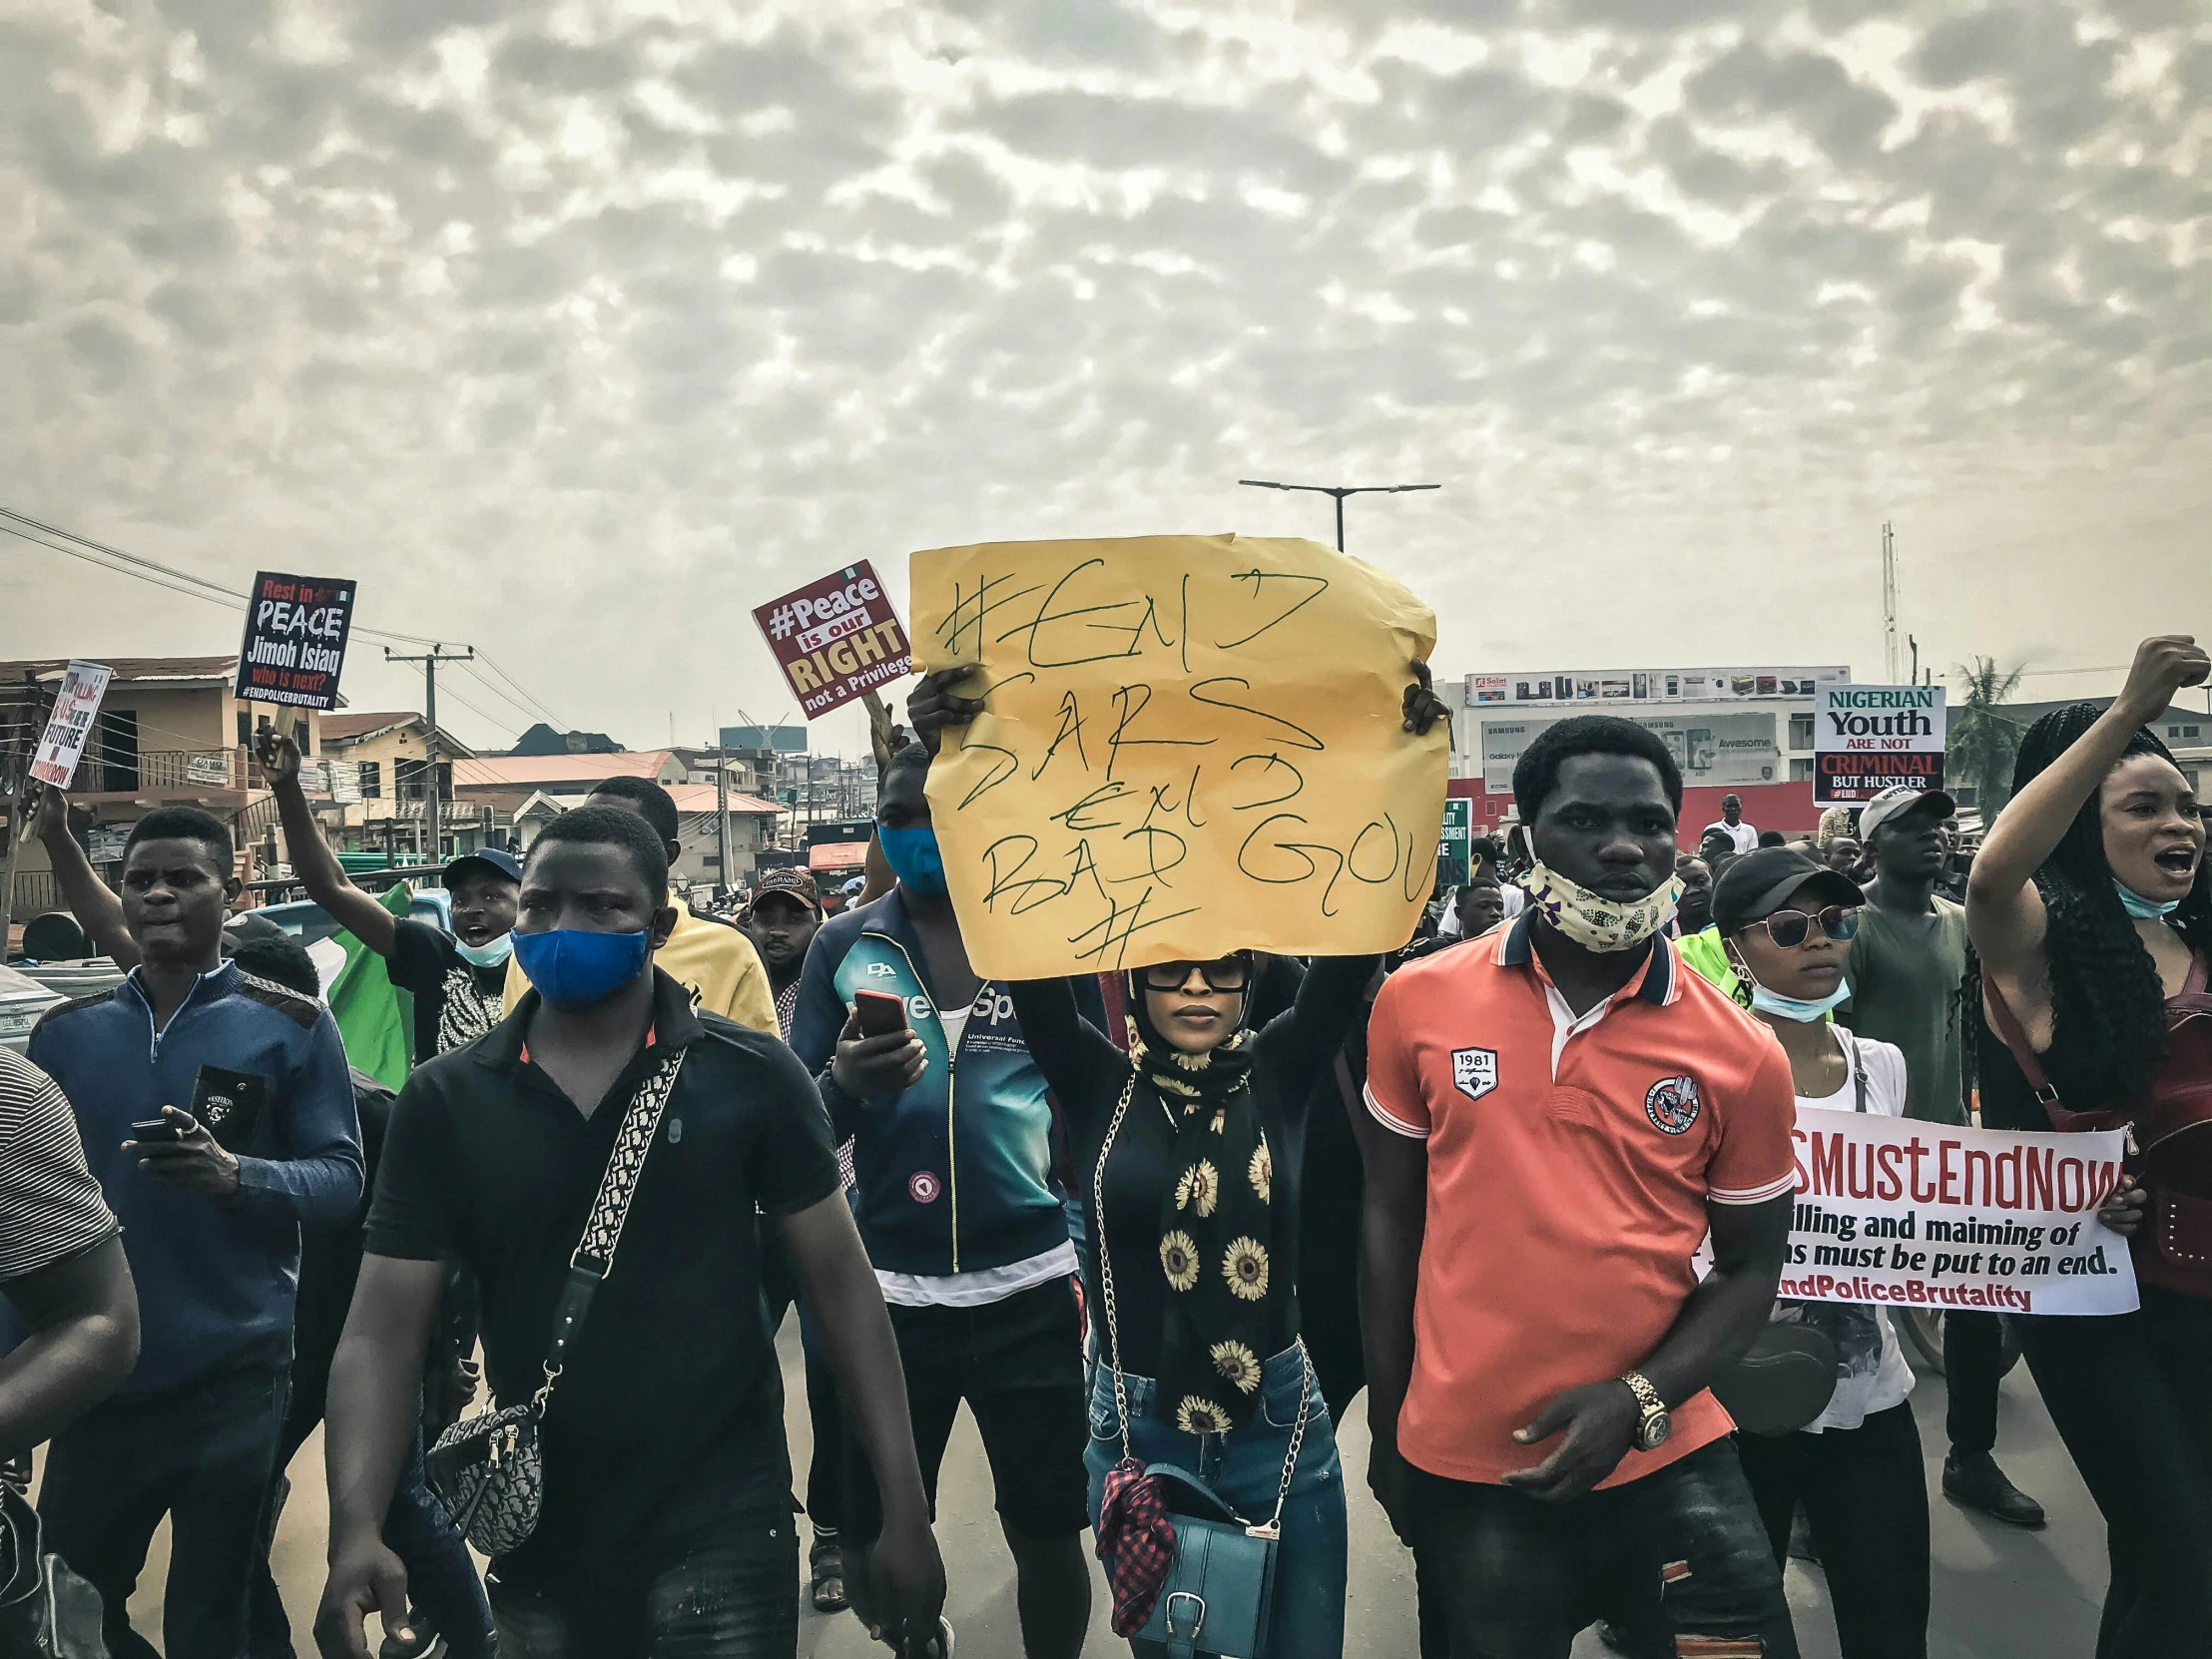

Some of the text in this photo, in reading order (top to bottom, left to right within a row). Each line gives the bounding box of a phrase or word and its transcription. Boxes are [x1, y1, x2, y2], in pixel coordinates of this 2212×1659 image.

[263, 579, 313, 603] Rest in
[257, 600, 344, 641] PEACE
[769, 578, 879, 641] #Peace
[802, 612, 865, 650] is our
[247, 635, 340, 677] Jimoh Isiaq
[787, 618, 902, 695] RIGHT
[252, 666, 327, 691] who is next?
[805, 655, 912, 712] not a Privilege
[243, 686, 329, 708] #ENDPOLICEBRUTALITY
[1829, 691, 1934, 708] NIGERIAN
[43, 724, 83, 750] FUTURE
[1827, 710, 1933, 736] Youth
[958, 673, 1325, 811] SARS
[1719, 739, 1771, 748] Awesome
[1847, 738, 1913, 750] ARE NOT
[31, 760, 70, 786] TOMORROW
[1821, 754, 1938, 776] CRIMINAL
[1832, 776, 1861, 788] BUT
[1050, 753, 1304, 830] END
[982, 826, 1187, 914] BAD
[1068, 886, 1201, 969] #
[972, 987, 1016, 1026] Sp
[1459, 1054, 1488, 1066] 1981
[1864, 1210, 1916, 1241] and
[1927, 1216, 2045, 1252] maiming
[2049, 1222, 2081, 1247] of
[1814, 1245, 1886, 1269] must
[1891, 1243, 1927, 1271] be
[1931, 1249, 1983, 1279] put
[1988, 1251, 2016, 1276] to
[2019, 1255, 2049, 1276] an
[2056, 1246, 2117, 1276] end.
